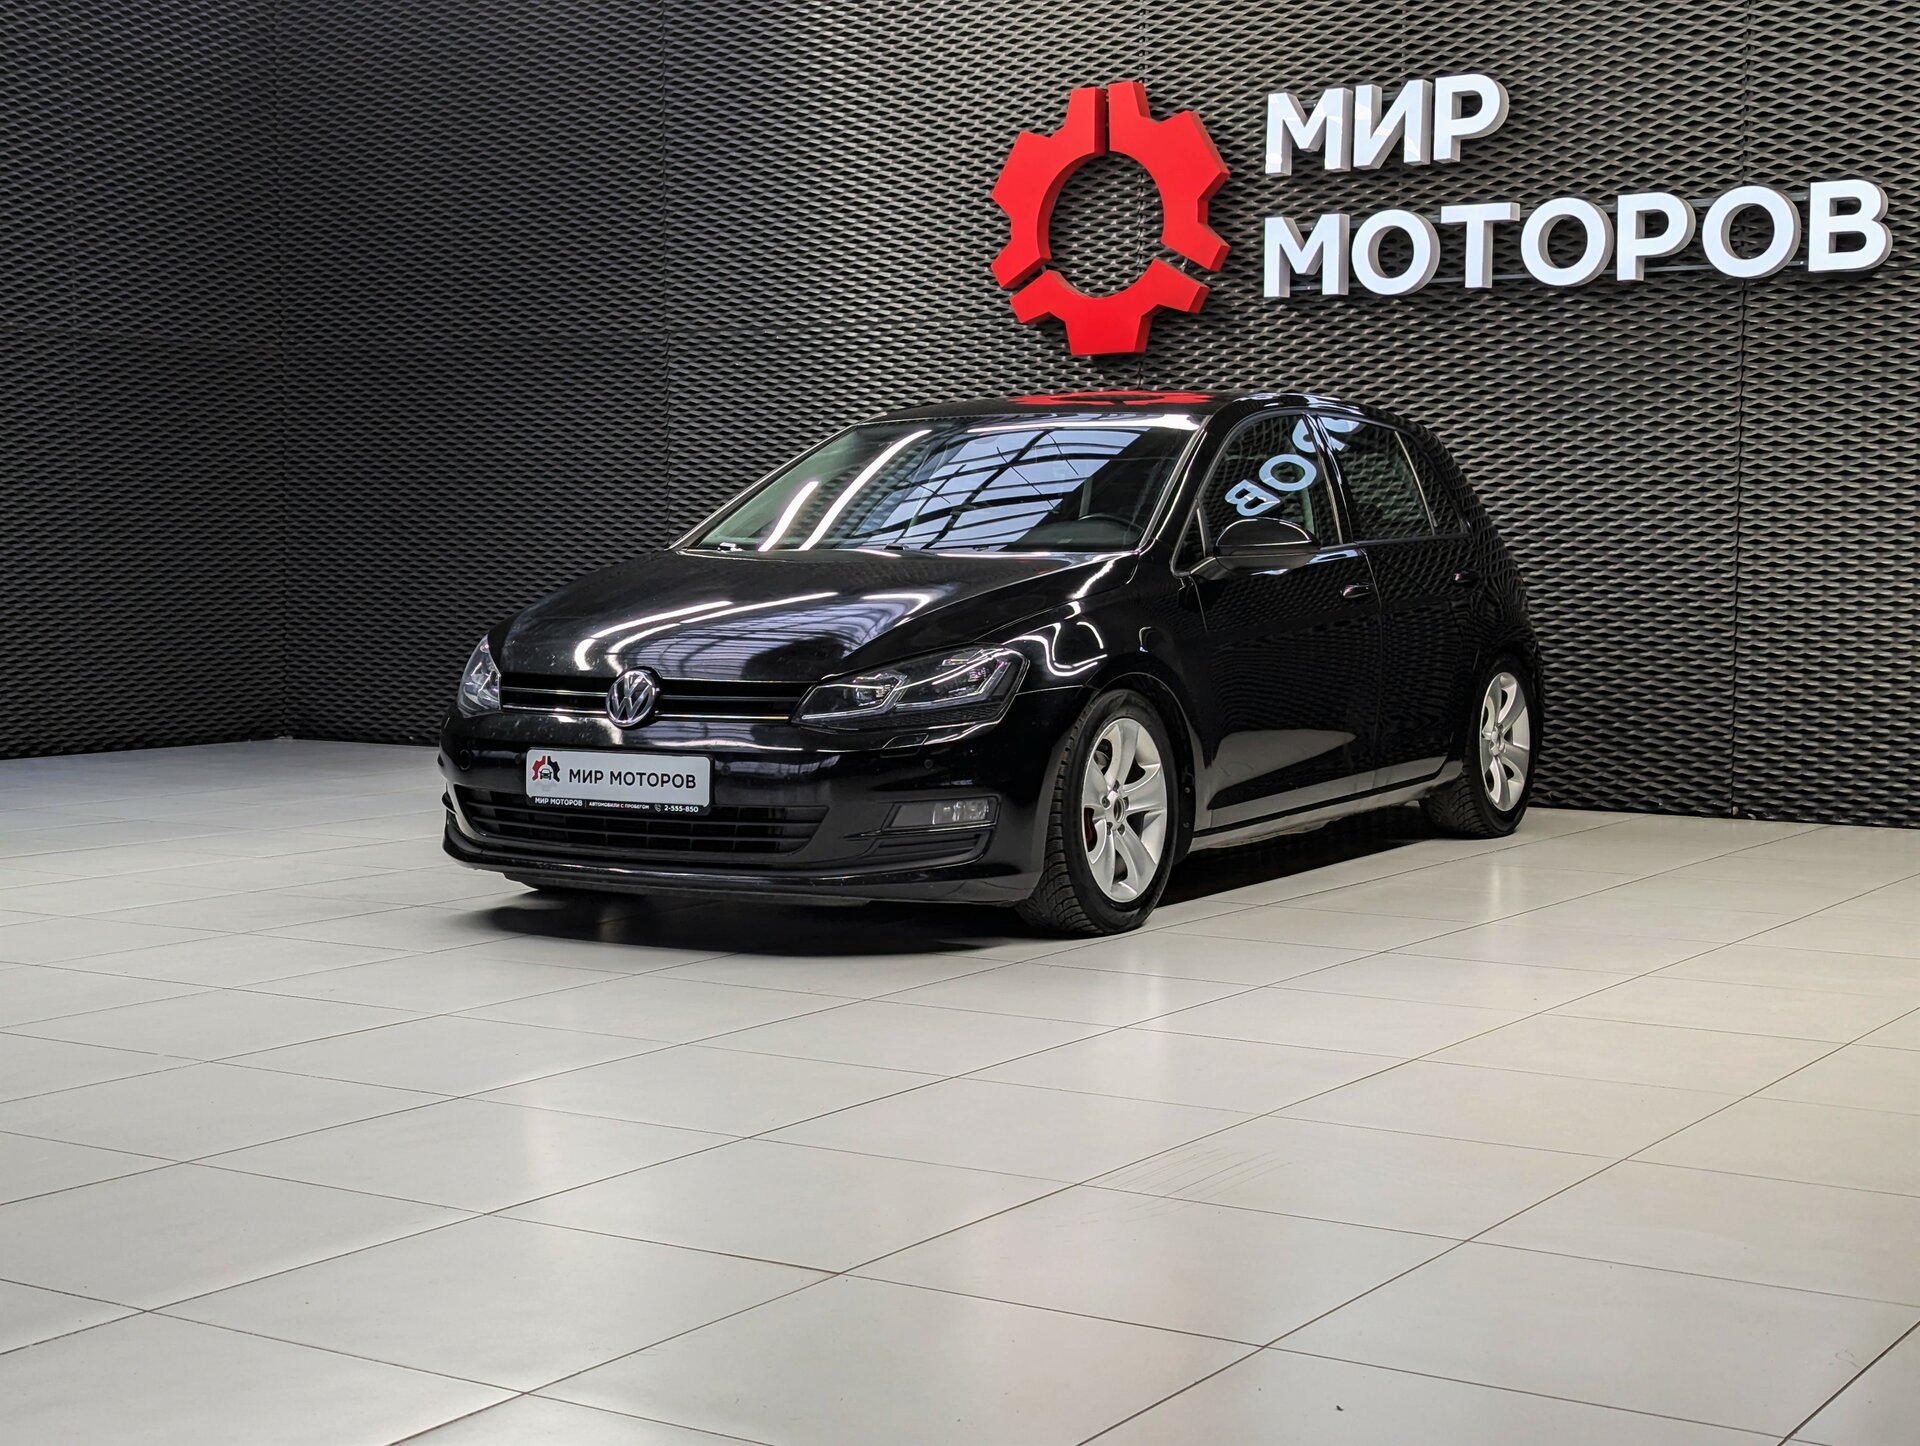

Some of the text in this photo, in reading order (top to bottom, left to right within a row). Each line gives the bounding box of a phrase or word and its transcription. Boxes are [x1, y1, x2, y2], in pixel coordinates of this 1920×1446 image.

[1265, 73, 1508, 177] МИР
[1263, 178, 1892, 298] МОТОРОВ
[550, 798, 583, 807] МОТОРОВ
[664, 805, 699, 813] 2-555-850
[569, 769, 696, 789] МИР МОТОРОВ
